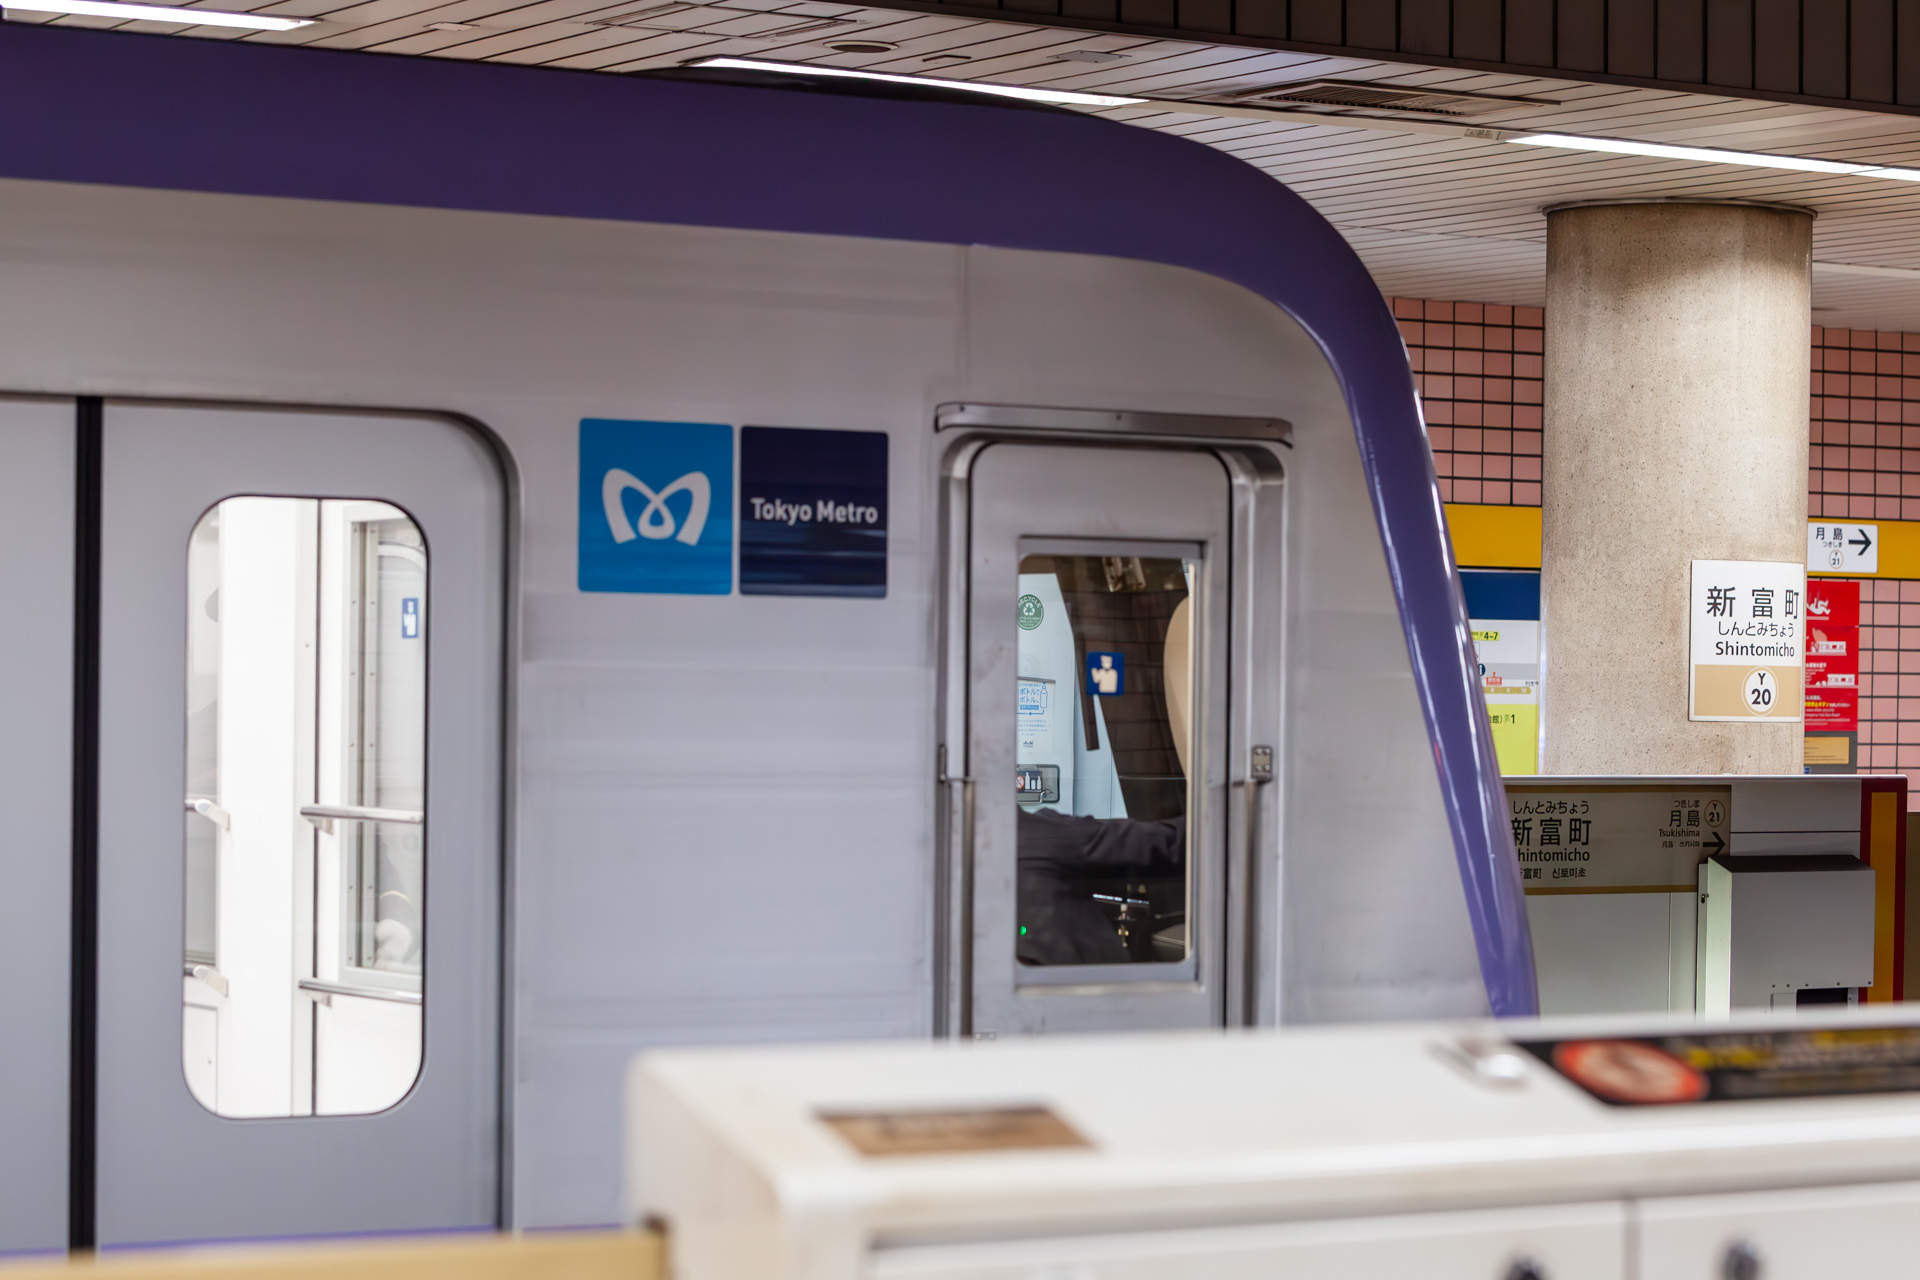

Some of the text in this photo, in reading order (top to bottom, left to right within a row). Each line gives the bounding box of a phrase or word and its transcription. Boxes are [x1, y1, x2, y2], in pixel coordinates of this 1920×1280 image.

[750, 497, 878, 526] Tokyo Metro
[1816, 527, 1843, 540] 月島
[1706, 586, 1799, 619] 新富町
[1718, 621, 1794, 638] しんとみちょう
[1715, 641, 1795, 657] Shintomicho
[1758, 673, 1766, 685] Y
[1751, 688, 1772, 706] 20
[1511, 714, 1515, 724] 1
[1513, 800, 1589, 814] しんとみちょう
[1674, 800, 1700, 808] つきしま
[1669, 810, 1700, 827] 月島
[1709, 812, 1720, 822] 21
[1511, 817, 1592, 846] 新富町
[1658, 828, 1700, 837] Tsukishima
[1518, 848, 1590, 862] hintomicho
[1552, 867, 1586, 878] 신토미초
